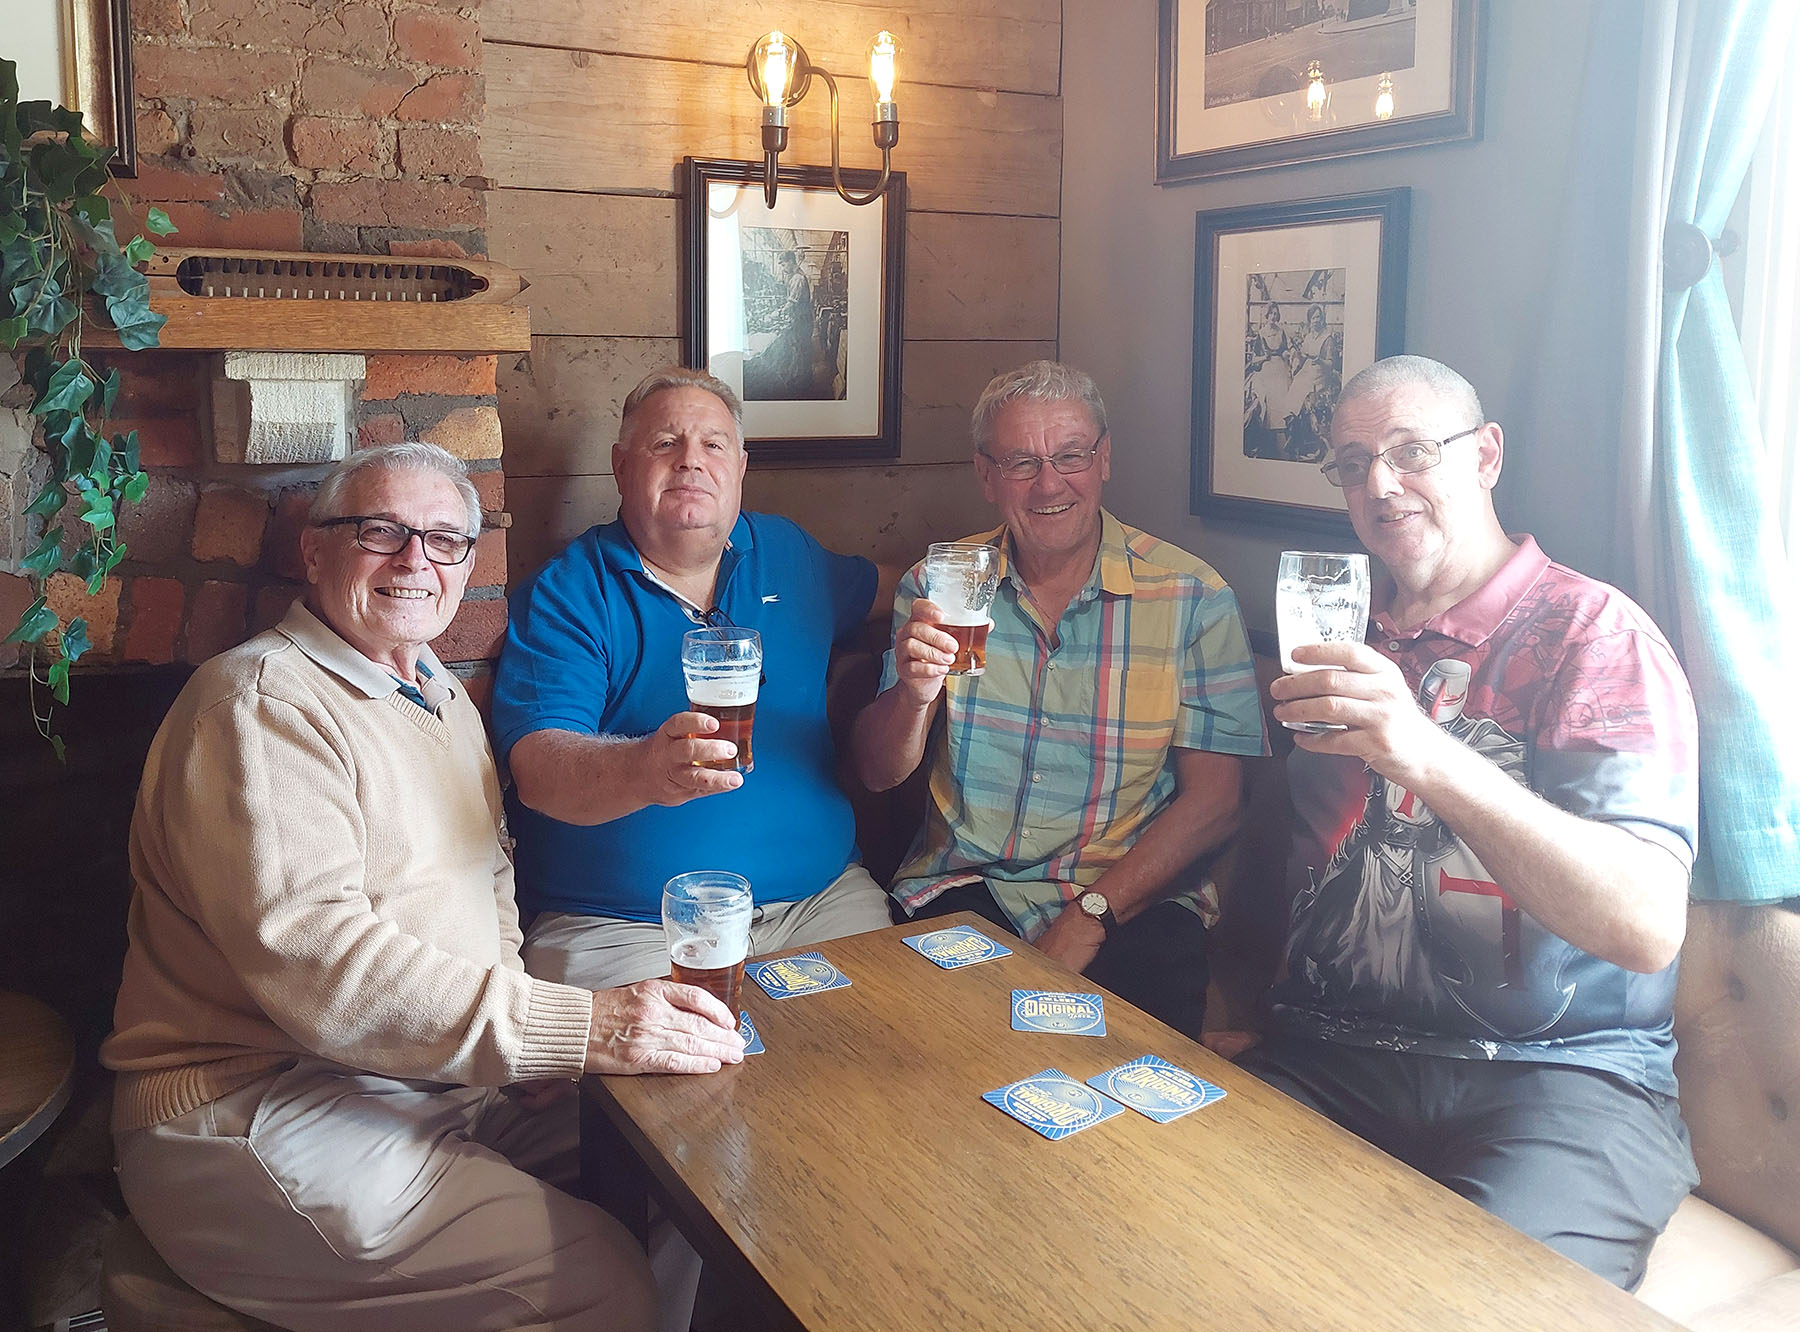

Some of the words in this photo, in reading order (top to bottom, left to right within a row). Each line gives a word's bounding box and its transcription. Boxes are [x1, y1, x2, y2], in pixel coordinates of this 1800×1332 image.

[933, 936, 991, 958] ORIGINAL
[1024, 1000, 1094, 1018] ORIGINAL
[1119, 1066, 1197, 1105] ORIGINAL
[1013, 1086, 1091, 1126] ORIGINAL
